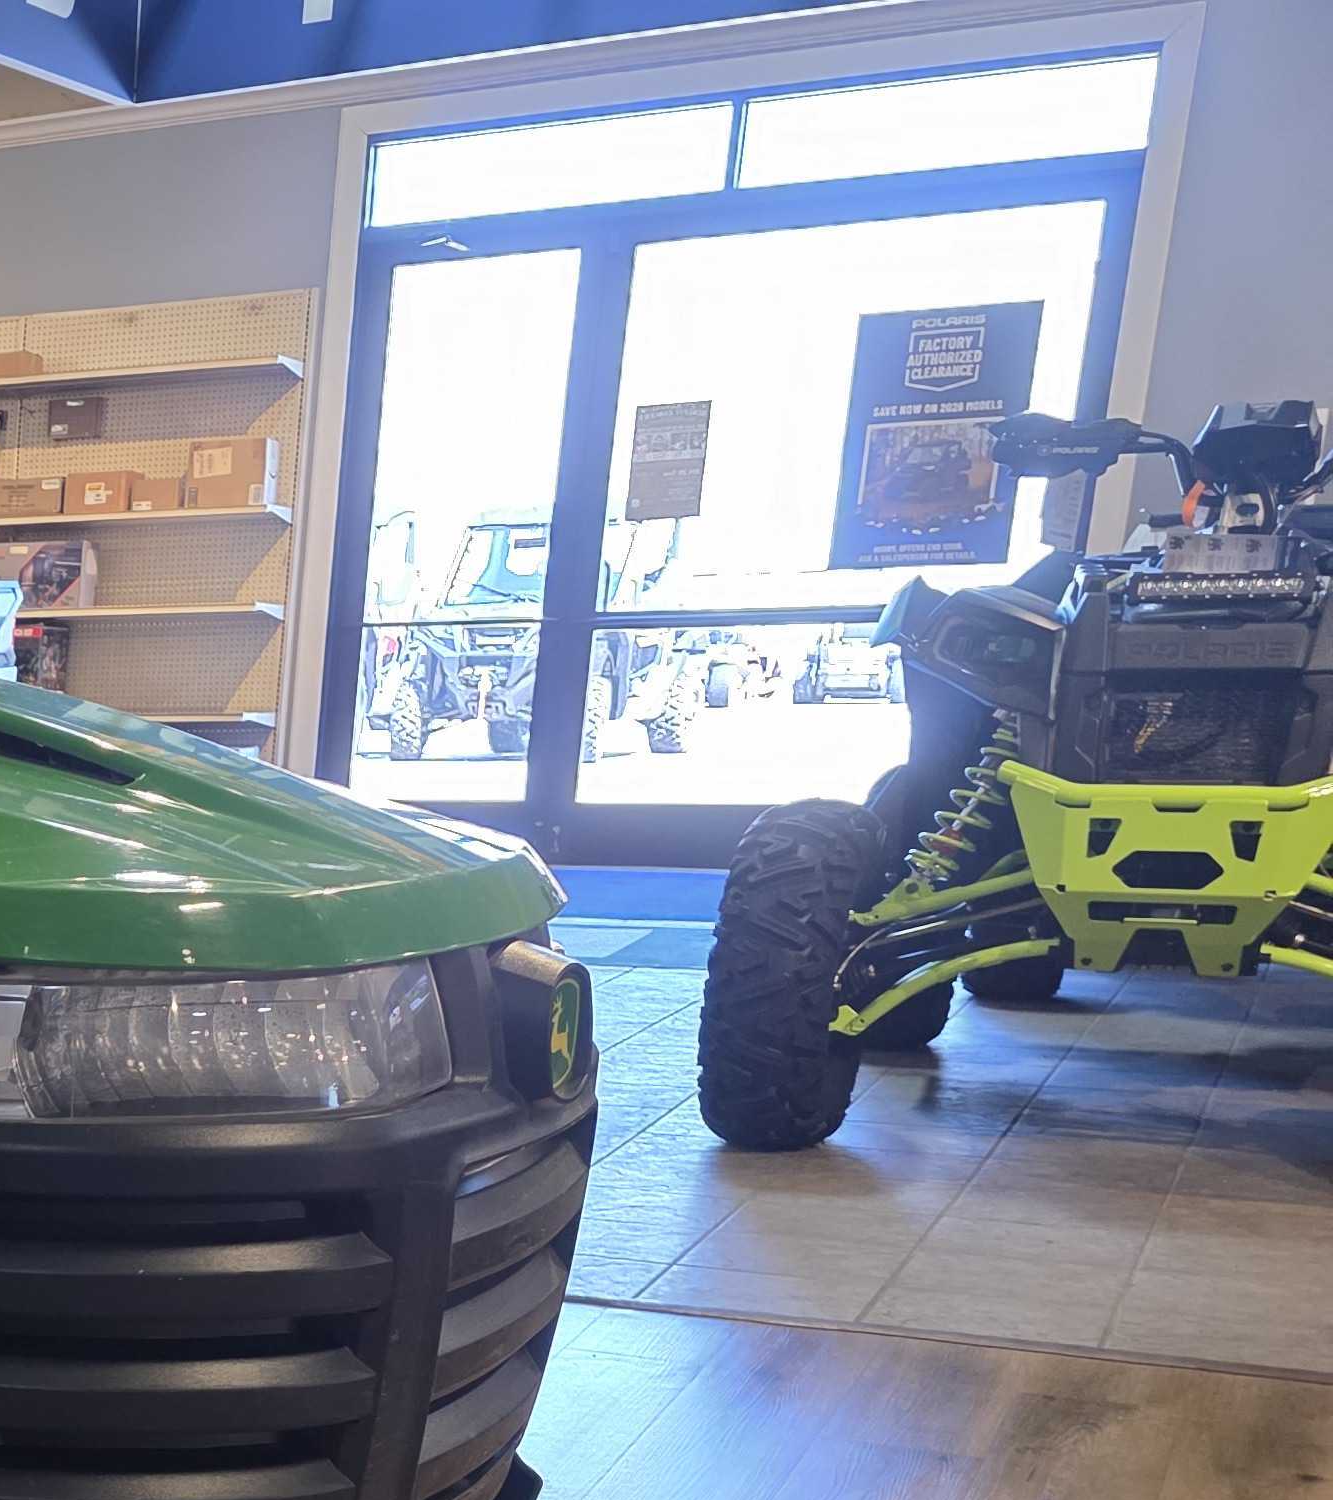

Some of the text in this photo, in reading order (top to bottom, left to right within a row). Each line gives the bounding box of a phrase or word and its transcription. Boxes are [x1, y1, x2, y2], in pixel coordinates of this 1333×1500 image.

[912, 314, 986, 329] POLARIS
[918, 336, 974, 353] FACTORY
[906, 350, 982, 368] AUTHORIZED
[911, 364, 976, 380] CLEARANCE
[873, 405, 898, 418] SAVE
[899, 404, 922, 415] NOW
[924, 403, 938, 414] ON
[965, 399, 1004, 411] MODELS
